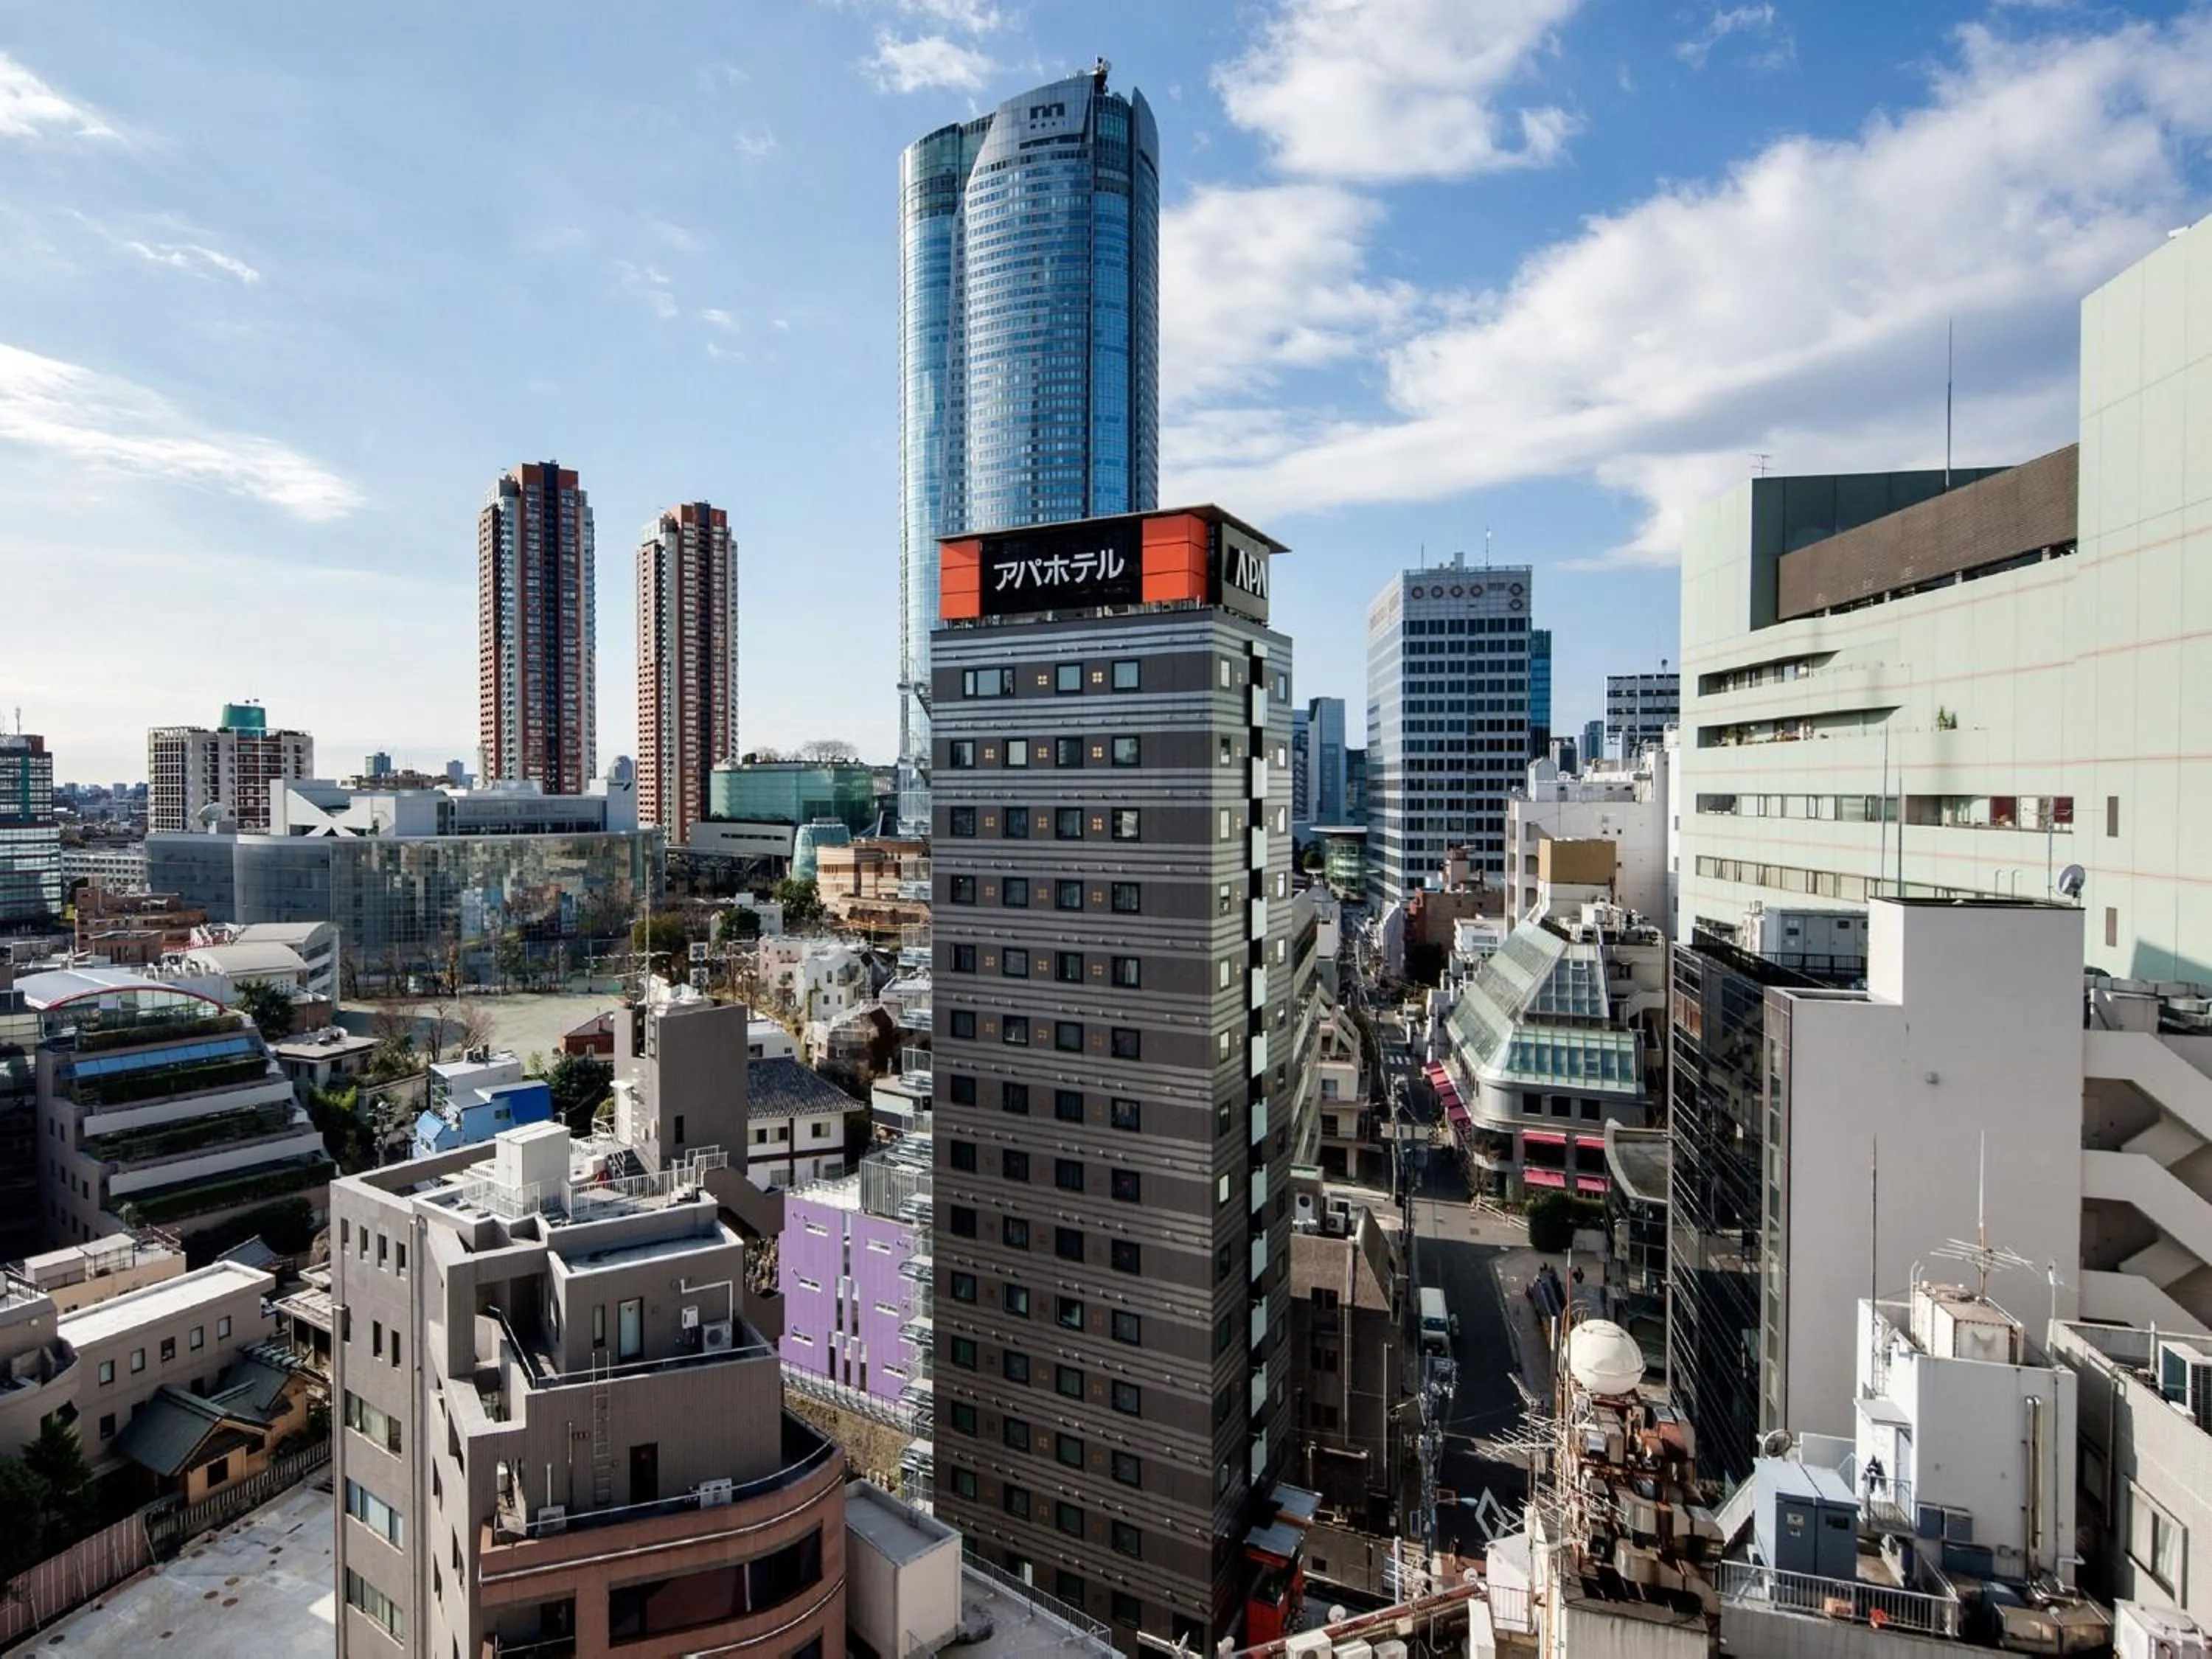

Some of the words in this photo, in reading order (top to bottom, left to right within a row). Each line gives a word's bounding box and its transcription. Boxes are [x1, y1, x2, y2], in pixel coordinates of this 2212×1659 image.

[993, 548, 1125, 591] アパホテル
[1235, 549, 1267, 598] APA
